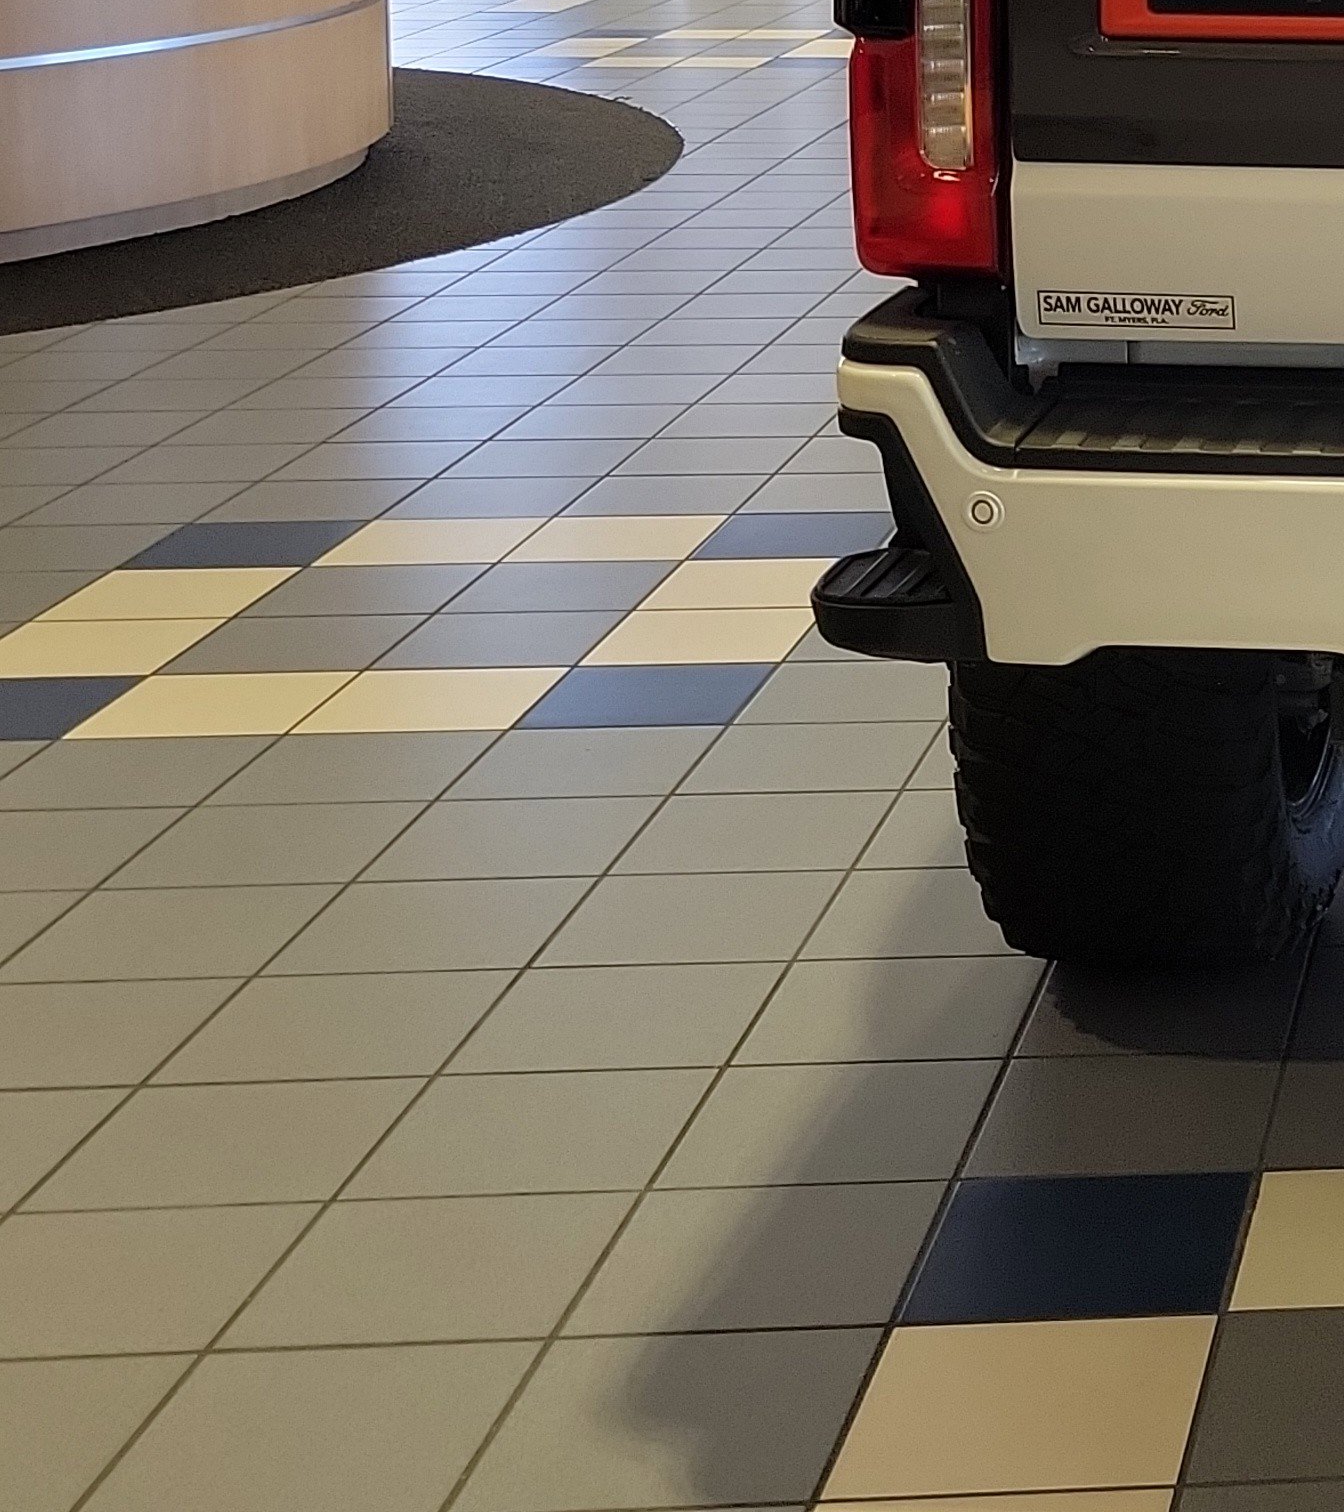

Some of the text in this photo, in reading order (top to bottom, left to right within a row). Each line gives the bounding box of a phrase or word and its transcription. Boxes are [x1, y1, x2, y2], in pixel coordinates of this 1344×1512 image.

[1043, 296, 1229, 317] SAM GALLOWAY Ford
